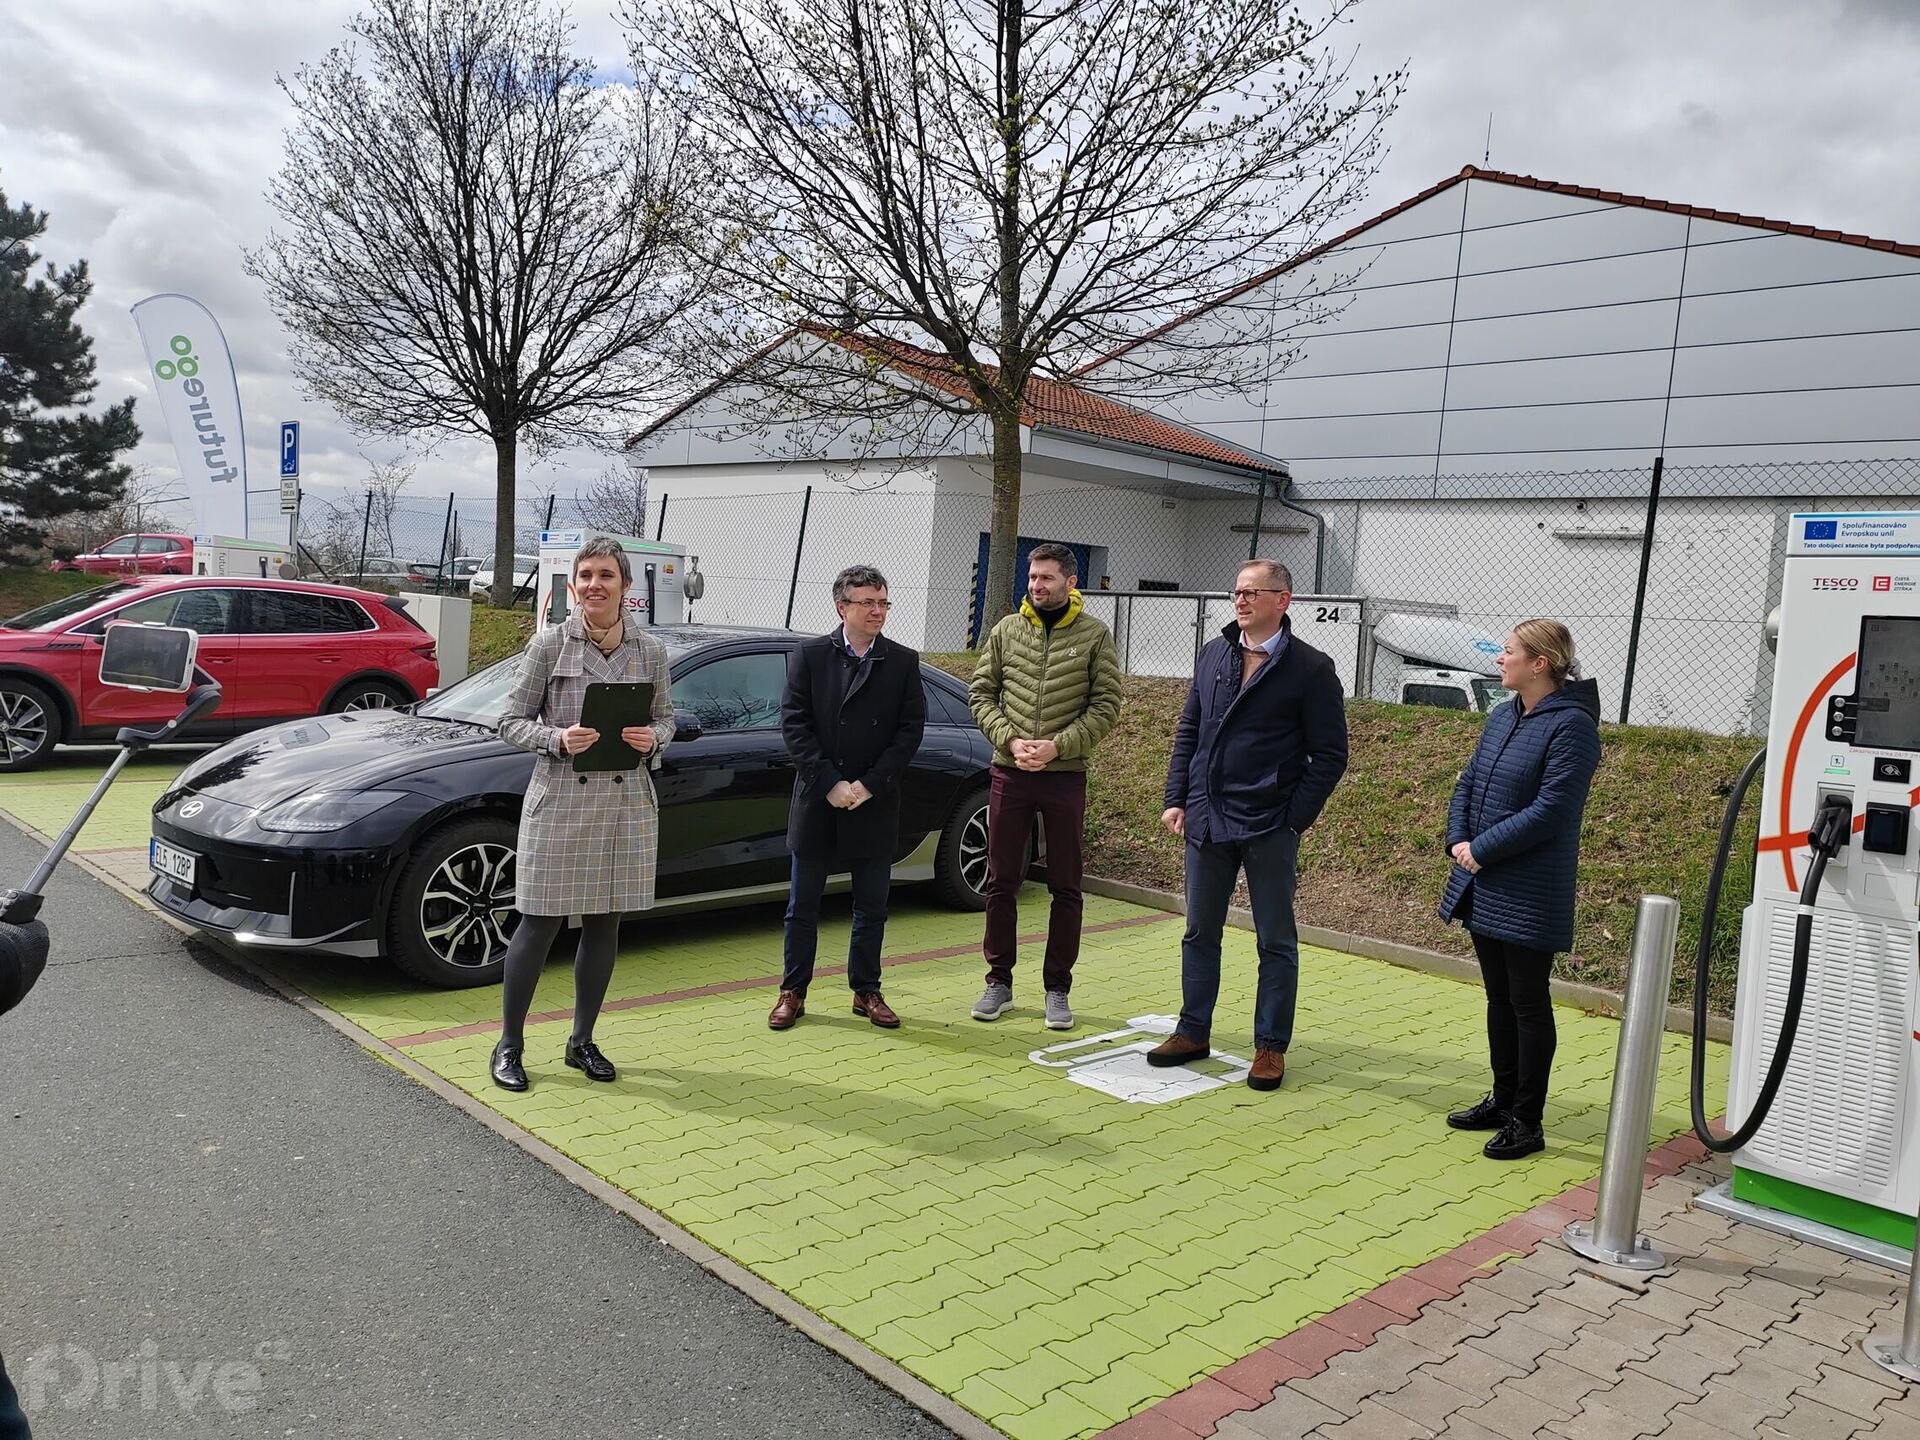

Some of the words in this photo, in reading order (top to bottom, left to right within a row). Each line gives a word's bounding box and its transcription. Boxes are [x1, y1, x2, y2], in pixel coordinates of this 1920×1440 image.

[284, 428, 294, 460] P
[1813, 577, 1859, 587] TESCO
[622, 597, 650, 608] ESC
[1315, 607, 1340, 623] 24
[173, 853, 191, 878] 12BP
